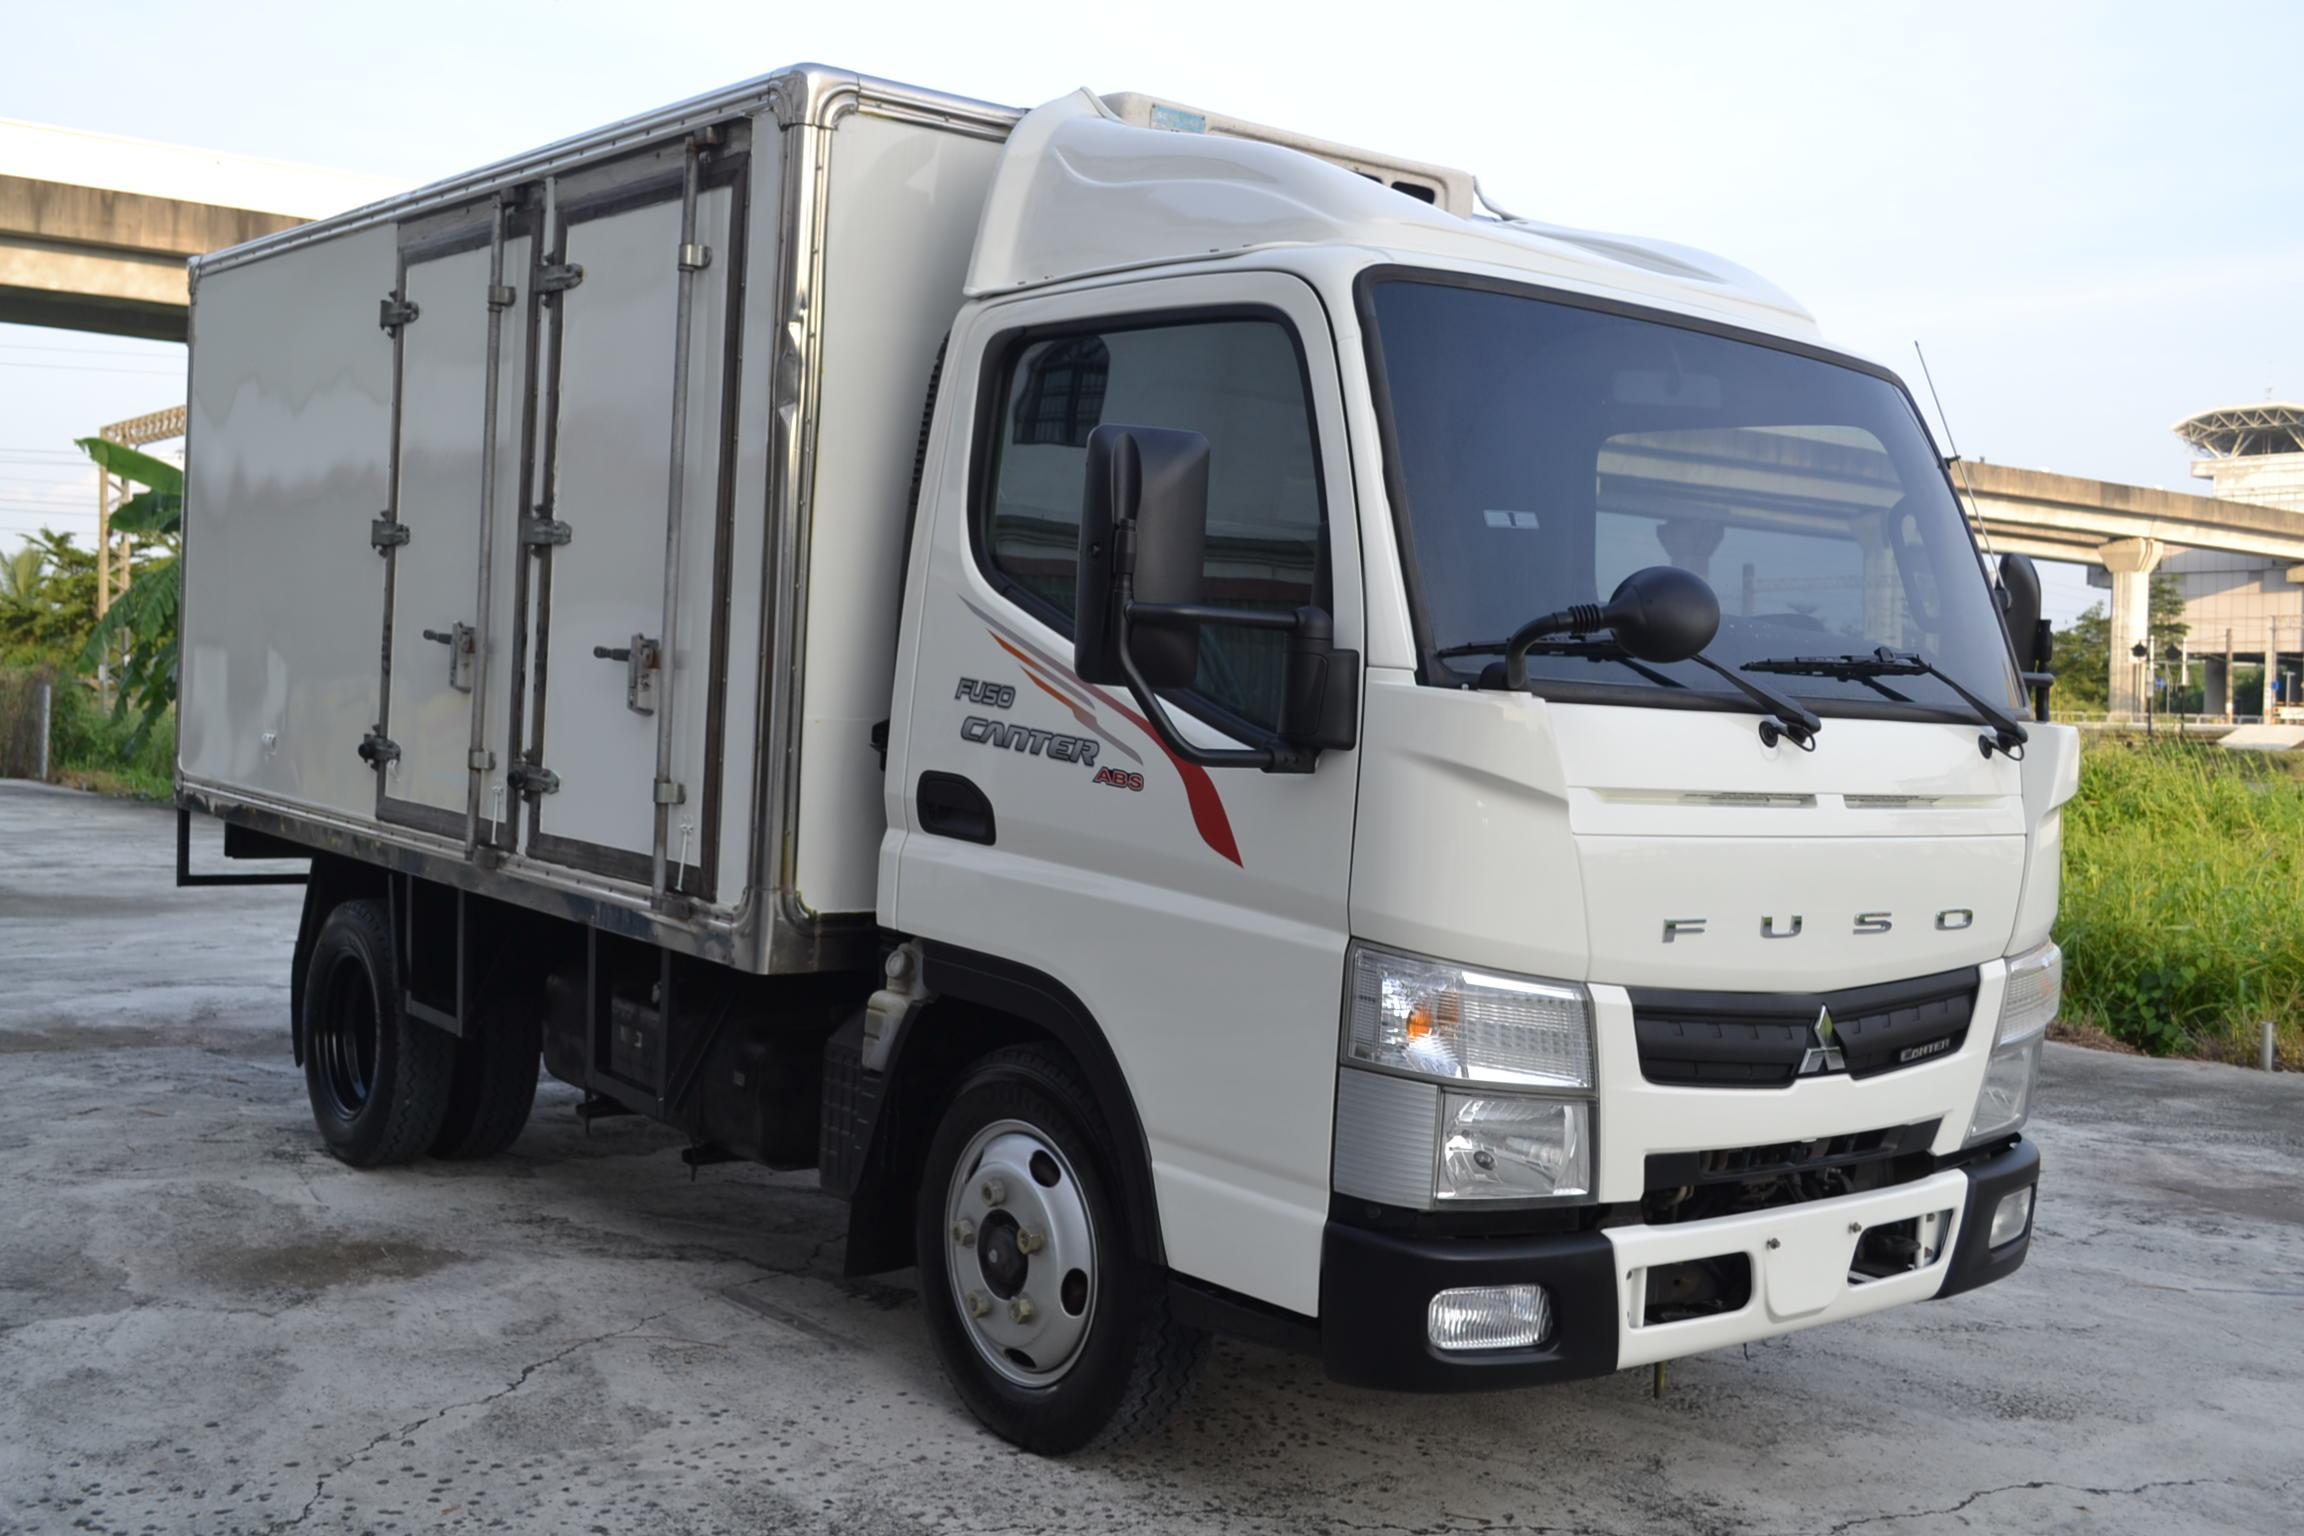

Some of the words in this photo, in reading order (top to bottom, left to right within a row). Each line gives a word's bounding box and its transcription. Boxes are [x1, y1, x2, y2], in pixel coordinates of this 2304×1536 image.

[955, 676, 1016, 709] FUSO
[960, 715, 1100, 767] CANTER
[1092, 766, 1144, 792] ABS
[1661, 908, 1974, 944] FUSO
